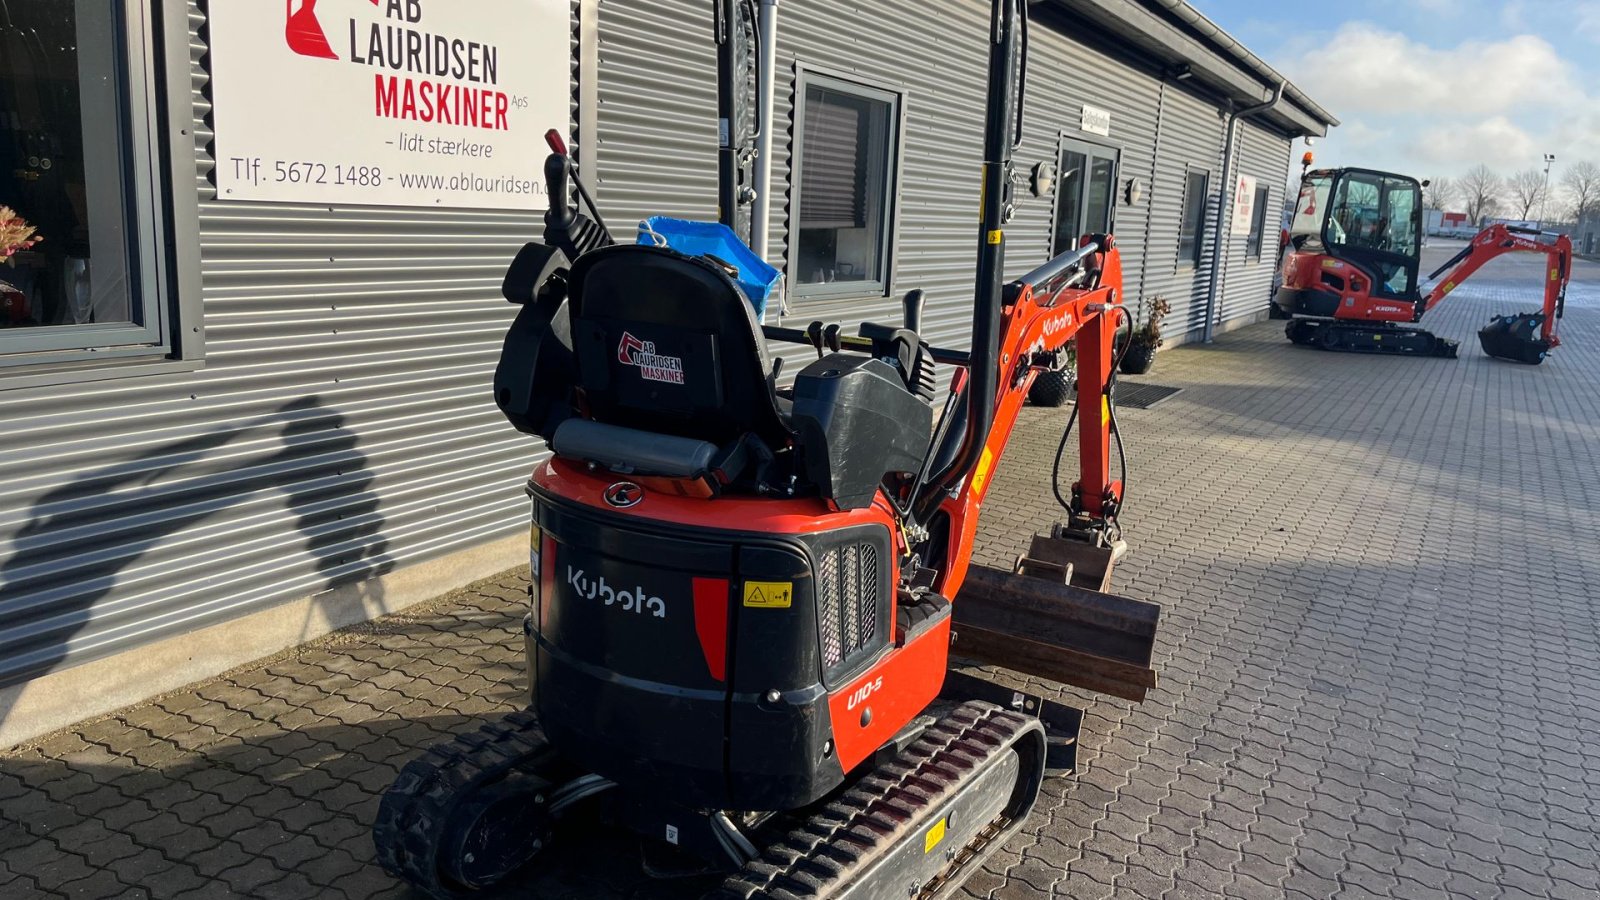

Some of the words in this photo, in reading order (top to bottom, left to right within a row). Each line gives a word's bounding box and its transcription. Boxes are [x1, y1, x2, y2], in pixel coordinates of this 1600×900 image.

[350, 18, 497, 85] LAURIDSEN
[375, 74, 508, 131] MASKINER
[511, 95, 529, 108] ApS
[400, 132, 424, 153] lidt
[428, 137, 493, 158] stærkere
[230, 158, 266, 186] Tlf.
[275, 161, 327, 184] 5672
[334, 165, 381, 187] 1488
[400, 172, 550, 196] www.ablauridsen.
[1042, 311, 1072, 336] Kubota
[633, 353, 681, 371] LAURIDSEN
[643, 341, 655, 354] AB
[642, 367, 684, 383] MASKINER
[567, 565, 666, 618] Kubota
[847, 675, 883, 711] U10-5
